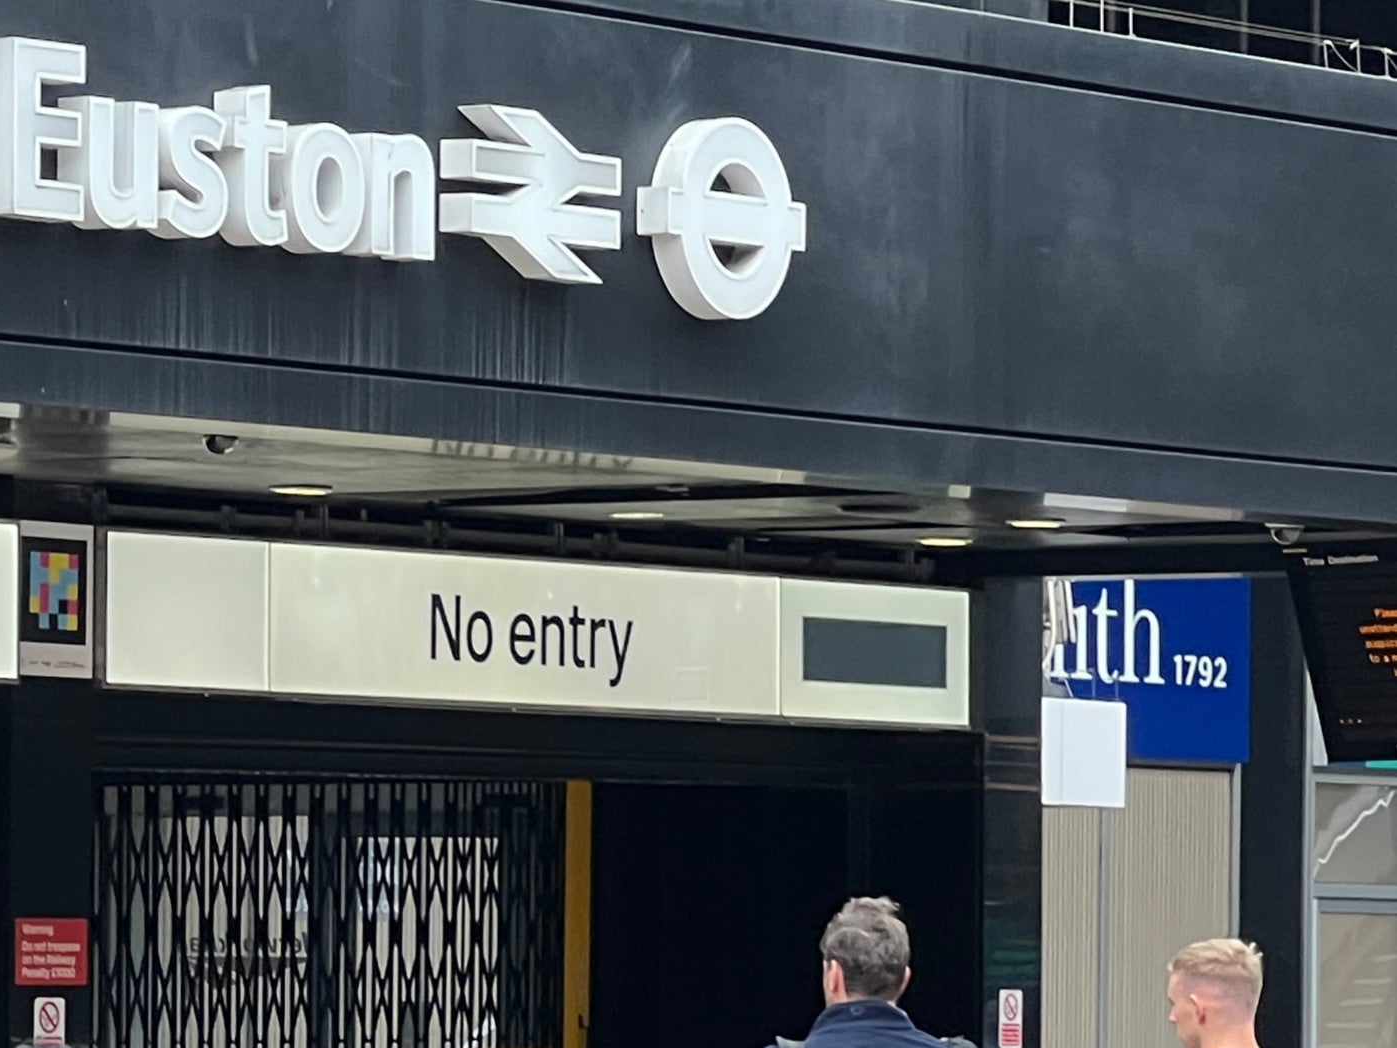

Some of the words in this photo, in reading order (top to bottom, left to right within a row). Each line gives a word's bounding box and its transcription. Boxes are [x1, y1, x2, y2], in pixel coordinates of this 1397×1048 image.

[430, 592, 494, 663] No
[508, 604, 634, 688] entry
[1172, 653, 1228, 688] 1792
